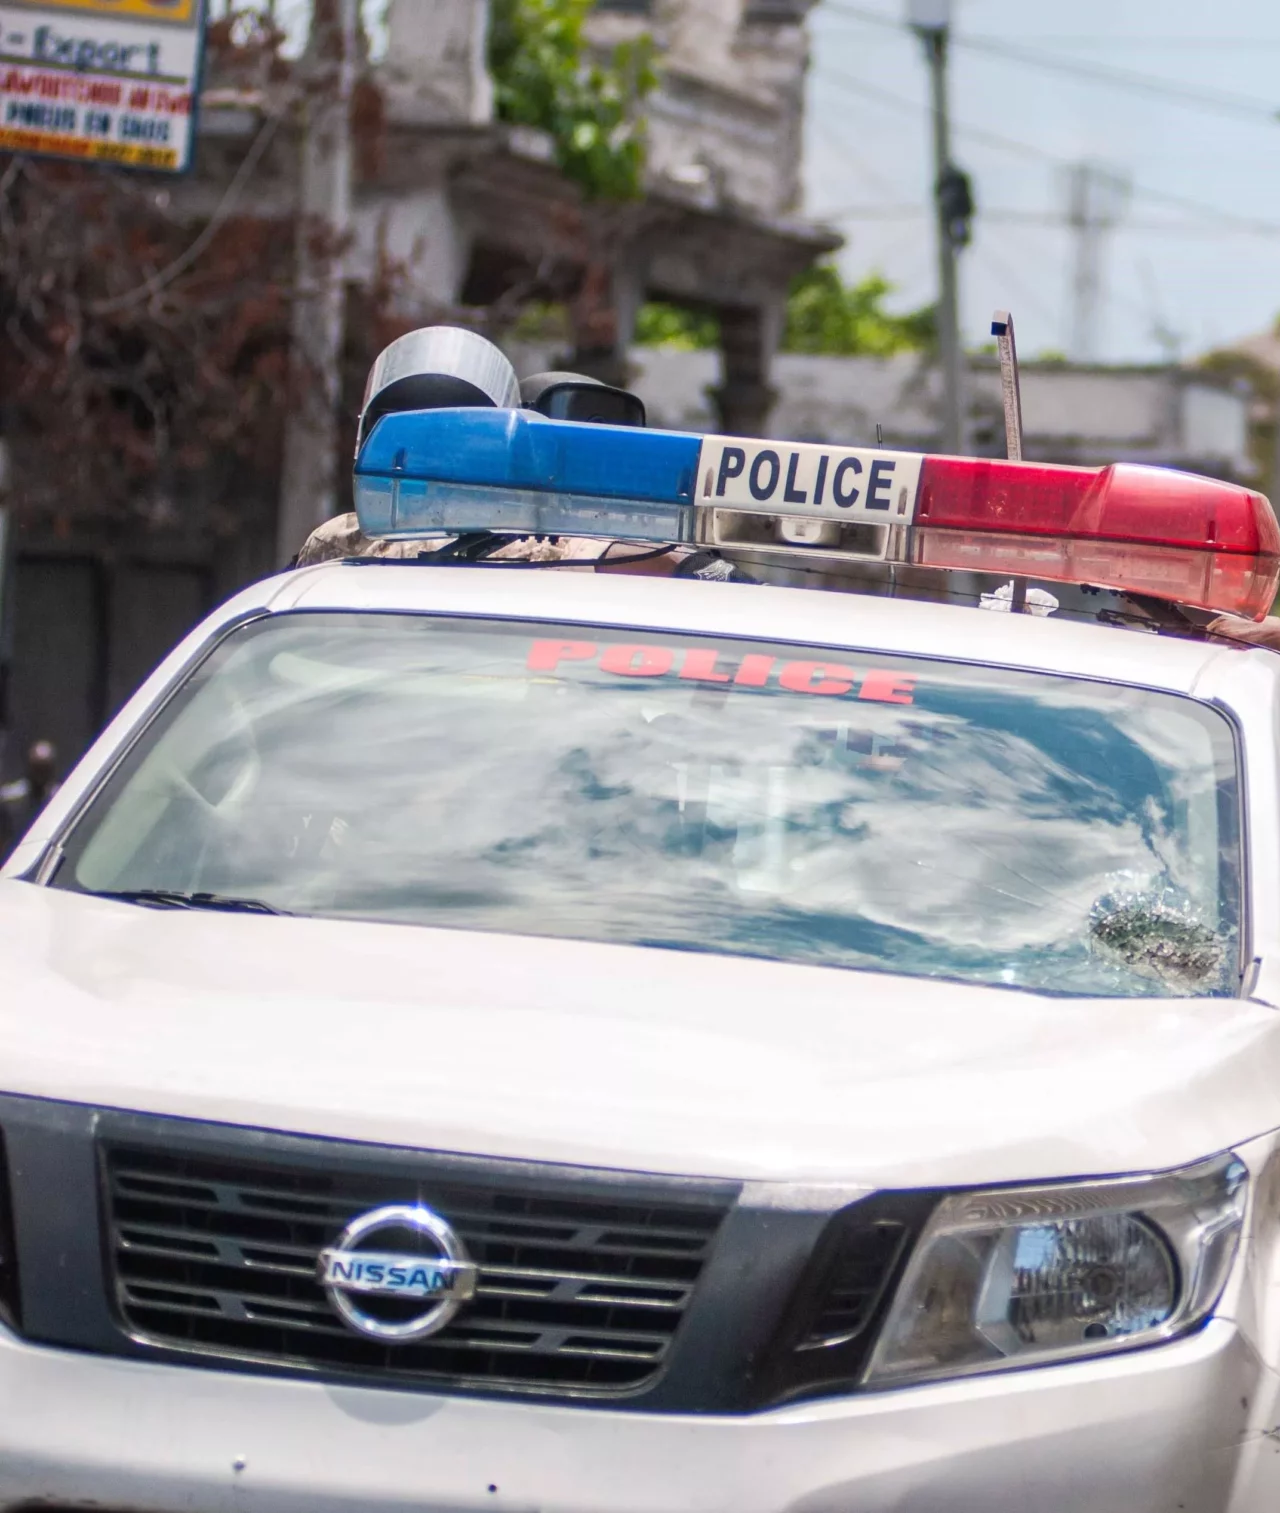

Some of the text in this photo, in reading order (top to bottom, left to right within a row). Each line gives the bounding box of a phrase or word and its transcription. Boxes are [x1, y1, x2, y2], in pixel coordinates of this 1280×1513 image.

[33, 25, 159, 73] Export
[715, 446, 896, 511] POLICE
[527, 639, 918, 704] POLICE
[332, 1261, 455, 1290] NISSAN
